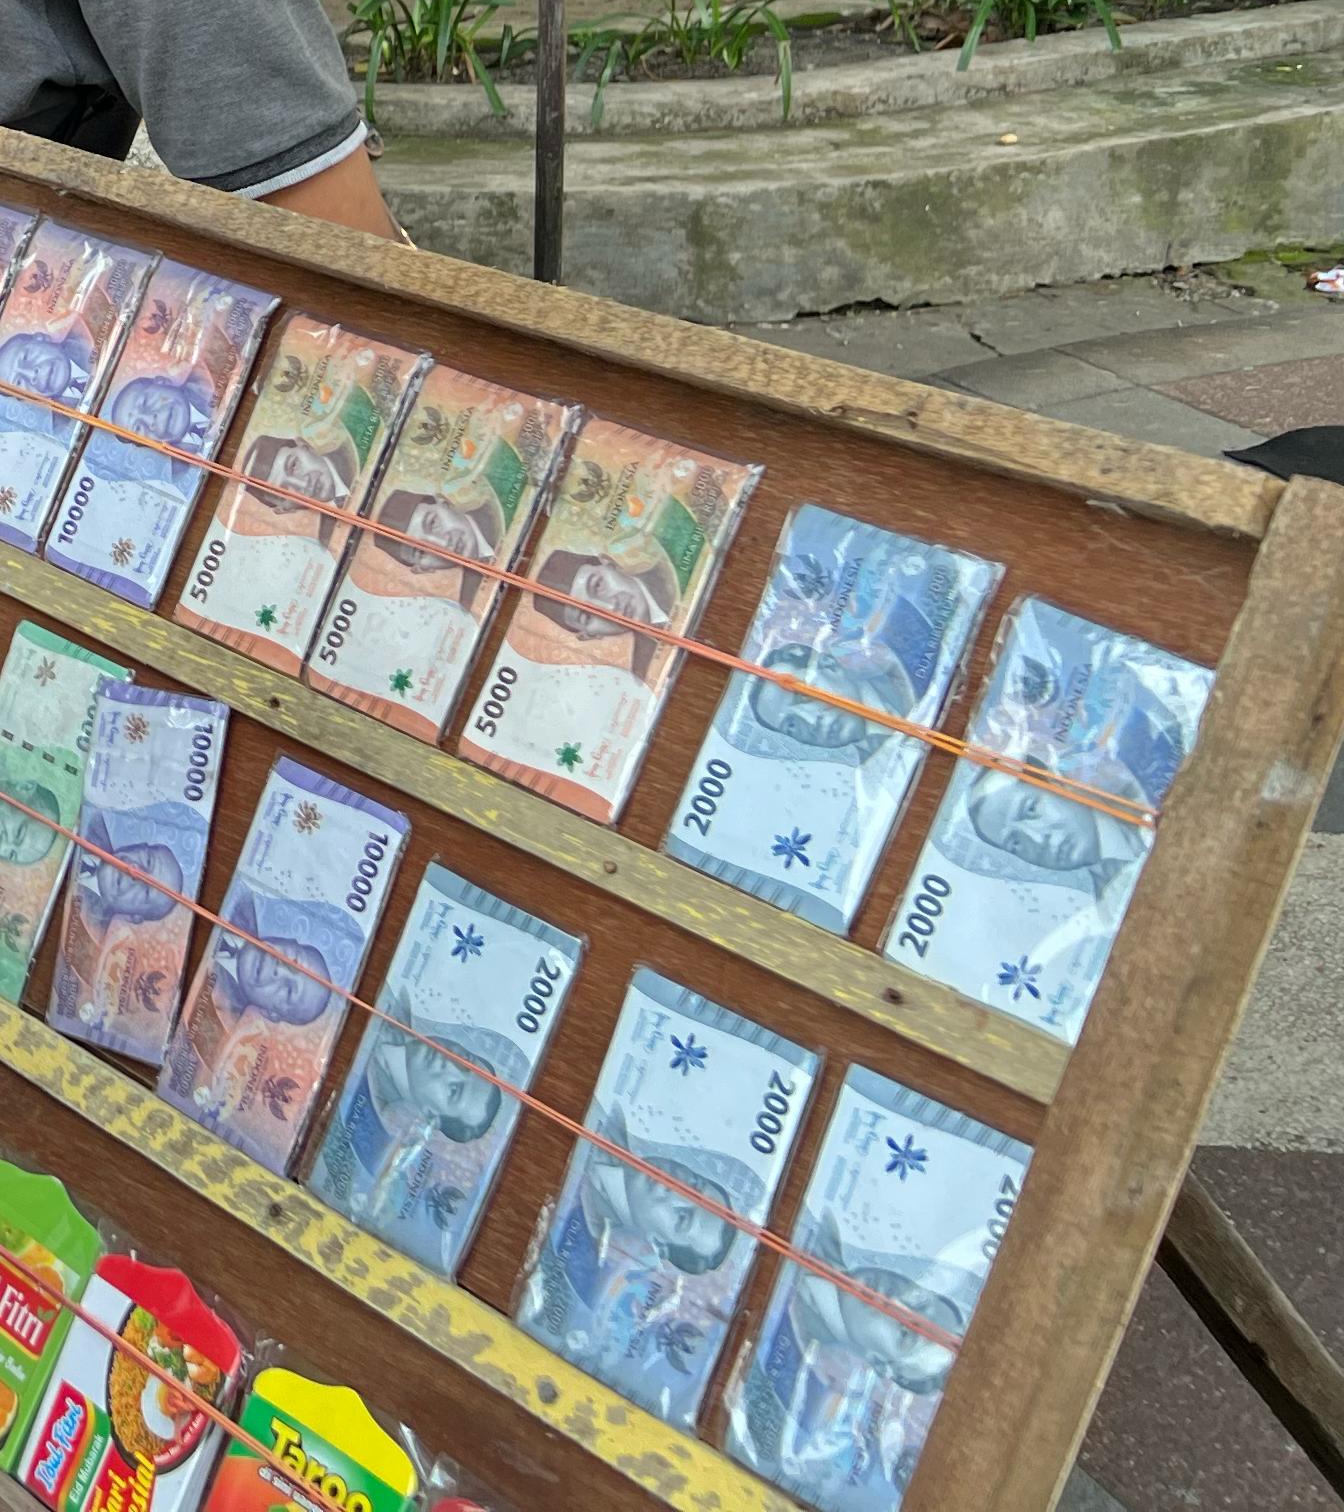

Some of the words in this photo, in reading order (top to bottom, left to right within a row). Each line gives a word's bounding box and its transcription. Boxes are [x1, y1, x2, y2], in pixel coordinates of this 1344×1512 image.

[302, 354, 331, 416] INDONESIA
[441, 406, 474, 471] INDONESIA
[55, 475, 98, 547] 10000
[606, 459, 639, 531] INDONESIA
[188, 538, 229, 604] 5000
[828, 556, 864, 632] INDONESIA
[317, 596, 360, 666] 5000
[474, 664, 520, 738] 5000
[183, 724, 213, 803] 10000
[682, 756, 735, 836] 2000
[344, 830, 390, 913] 10000
[897, 872, 953, 957] 2000
[514, 954, 561, 1035] 2000
[237, 1044, 268, 1111] INDONESIA
[747, 1069, 797, 1156] 2000
[397, 1149, 433, 1220] INDONESIA
[978, 1173, 1023, 1261] 2000
[623, 1282, 662, 1359] INDOESIA
[65, 1479, 84, 1504] Eid
[74, 1433, 106, 1483] Mubarak
[270, 1416, 373, 1512] Taroo
